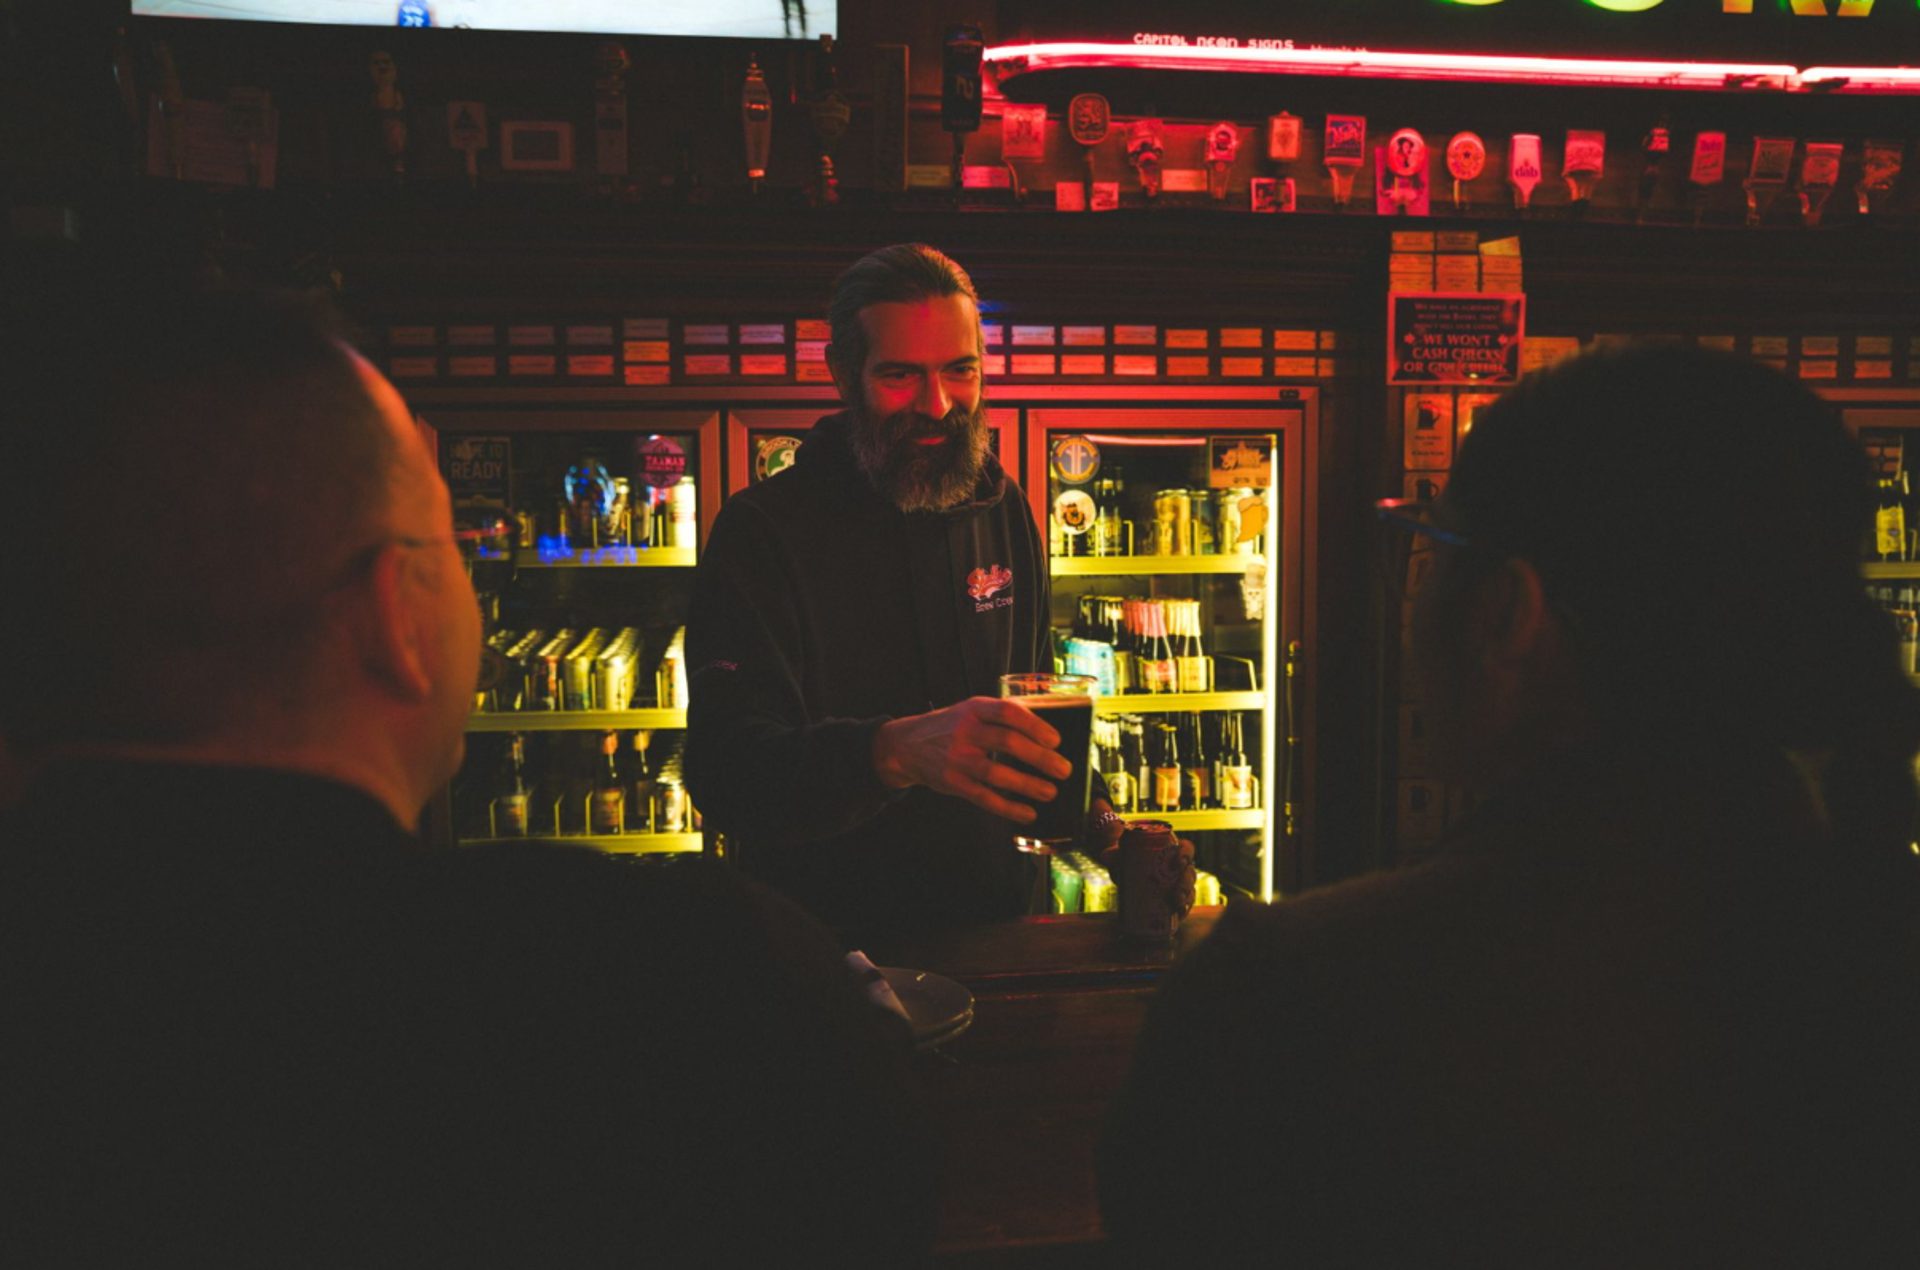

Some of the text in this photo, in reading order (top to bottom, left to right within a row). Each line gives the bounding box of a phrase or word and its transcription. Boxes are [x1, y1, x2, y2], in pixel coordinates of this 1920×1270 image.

[1133, 32, 1188, 47] CAPITOL
[1196, 36, 1239, 49] NEON
[1247, 38, 1295, 51] SIGNS
[1515, 166, 1539, 178] dab
[1423, 333, 1491, 346] WE WON'T
[1412, 346, 1503, 361] CASH CHECKS
[1403, 361, 1425, 373] OR
[450, 461, 504, 479] READY
